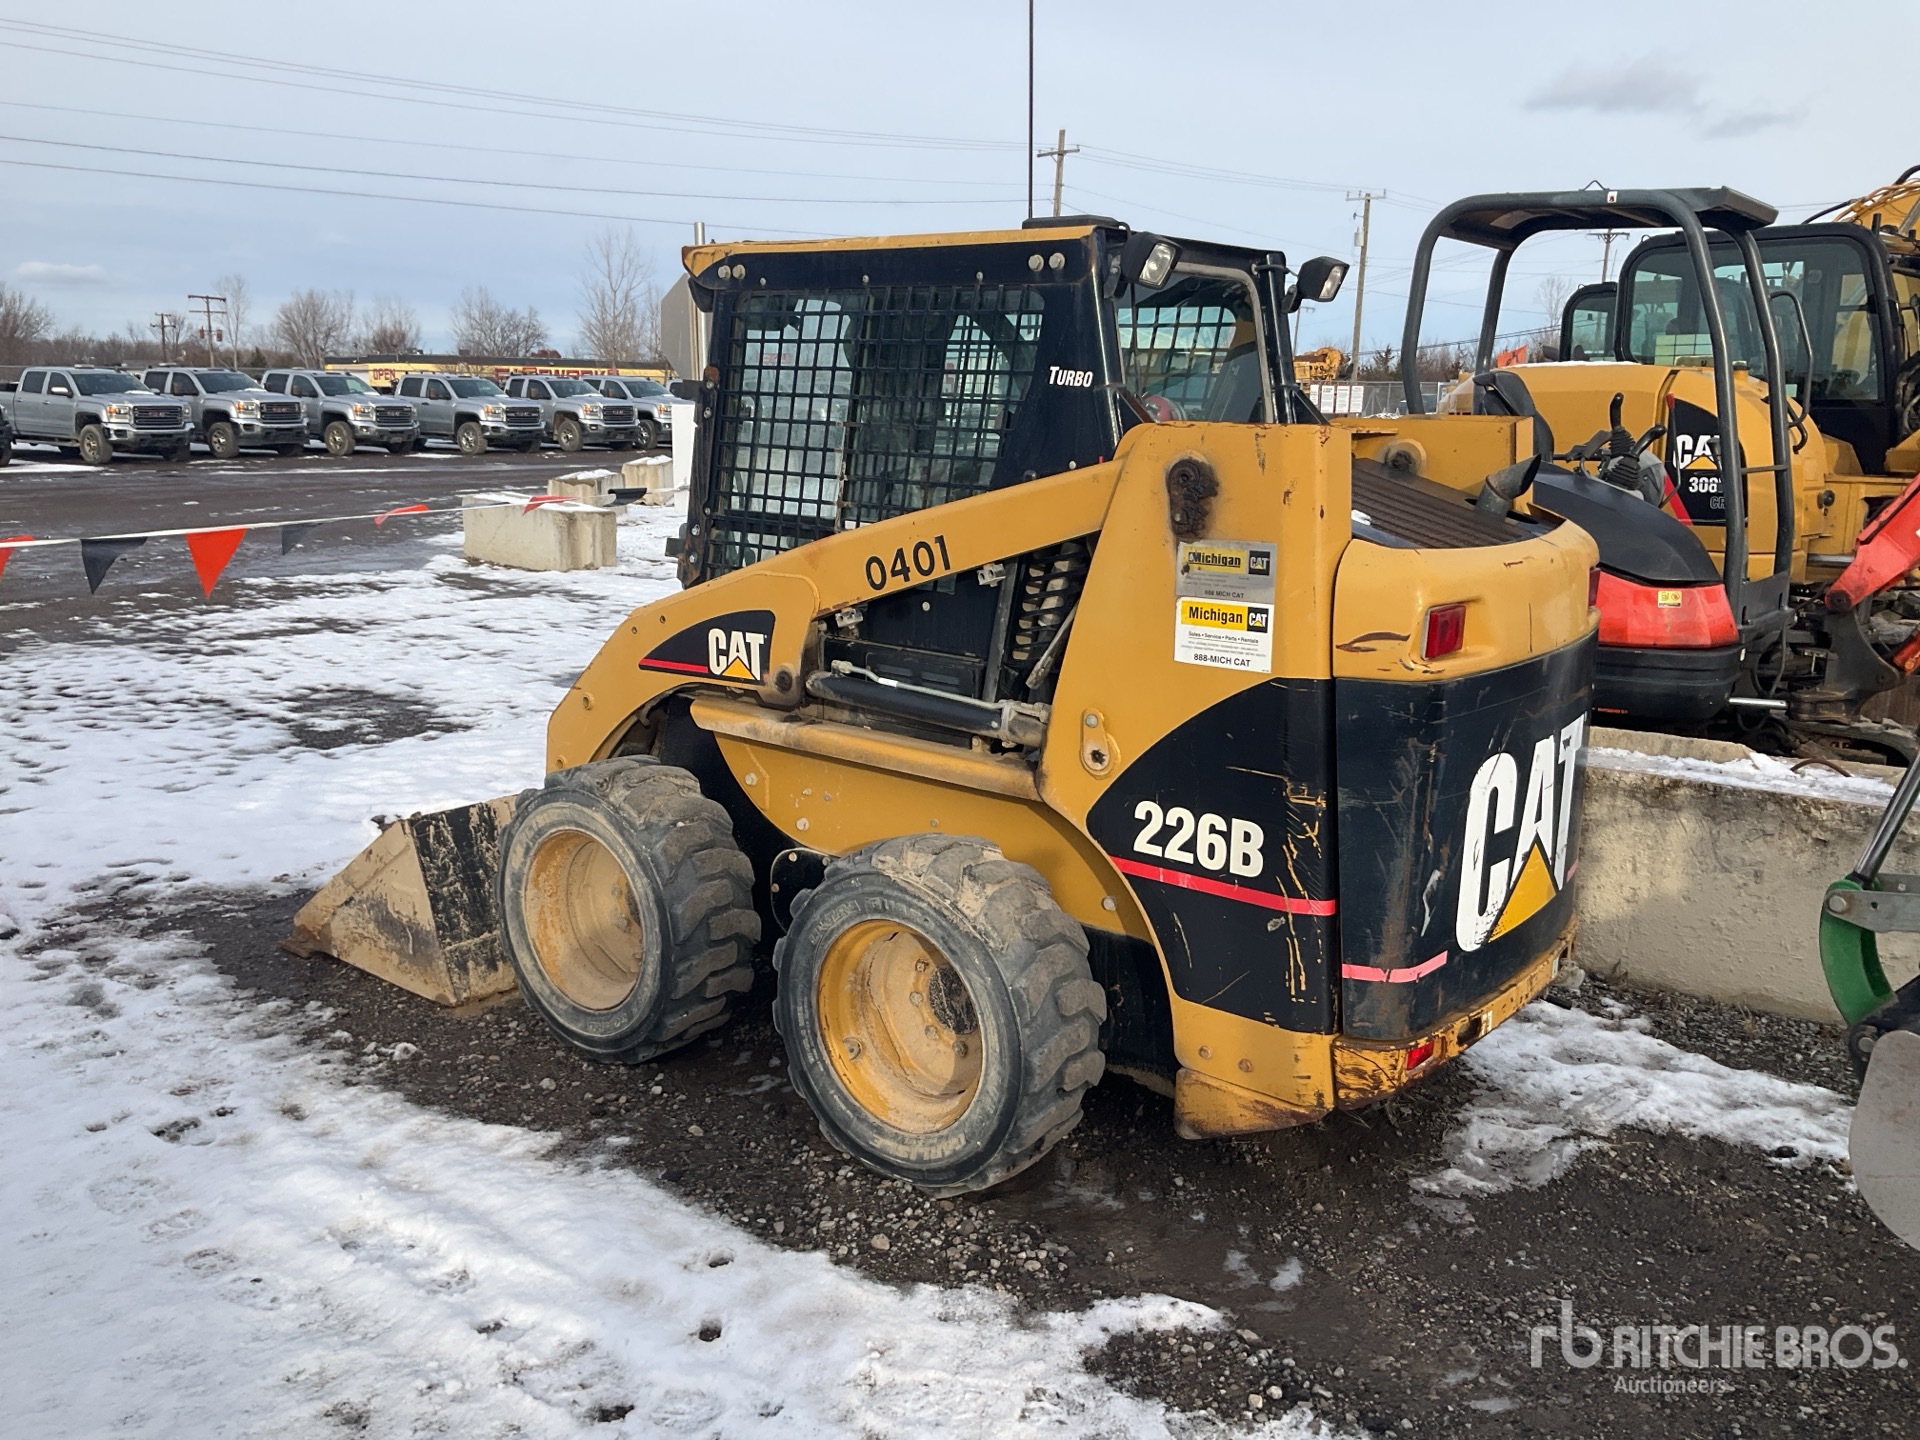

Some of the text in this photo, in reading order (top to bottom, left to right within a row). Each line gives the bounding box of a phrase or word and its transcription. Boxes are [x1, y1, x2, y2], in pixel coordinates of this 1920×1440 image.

[373, 368, 396, 381] OPEN
[1672, 434, 1723, 470] CA
[865, 534, 951, 591] 0401
[1188, 551, 1268, 570] Michigan CAT
[1216, 590, 1231, 598] MICH
[1188, 606, 1267, 627] Michigan CAT
[708, 628, 765, 681] CAT
[1193, 653, 1251, 667] 888-MICH CAT
[1133, 800, 1264, 878] 226B
[1456, 711, 1588, 953] CAT
[869, 1130, 967, 1161] CARLISLE
